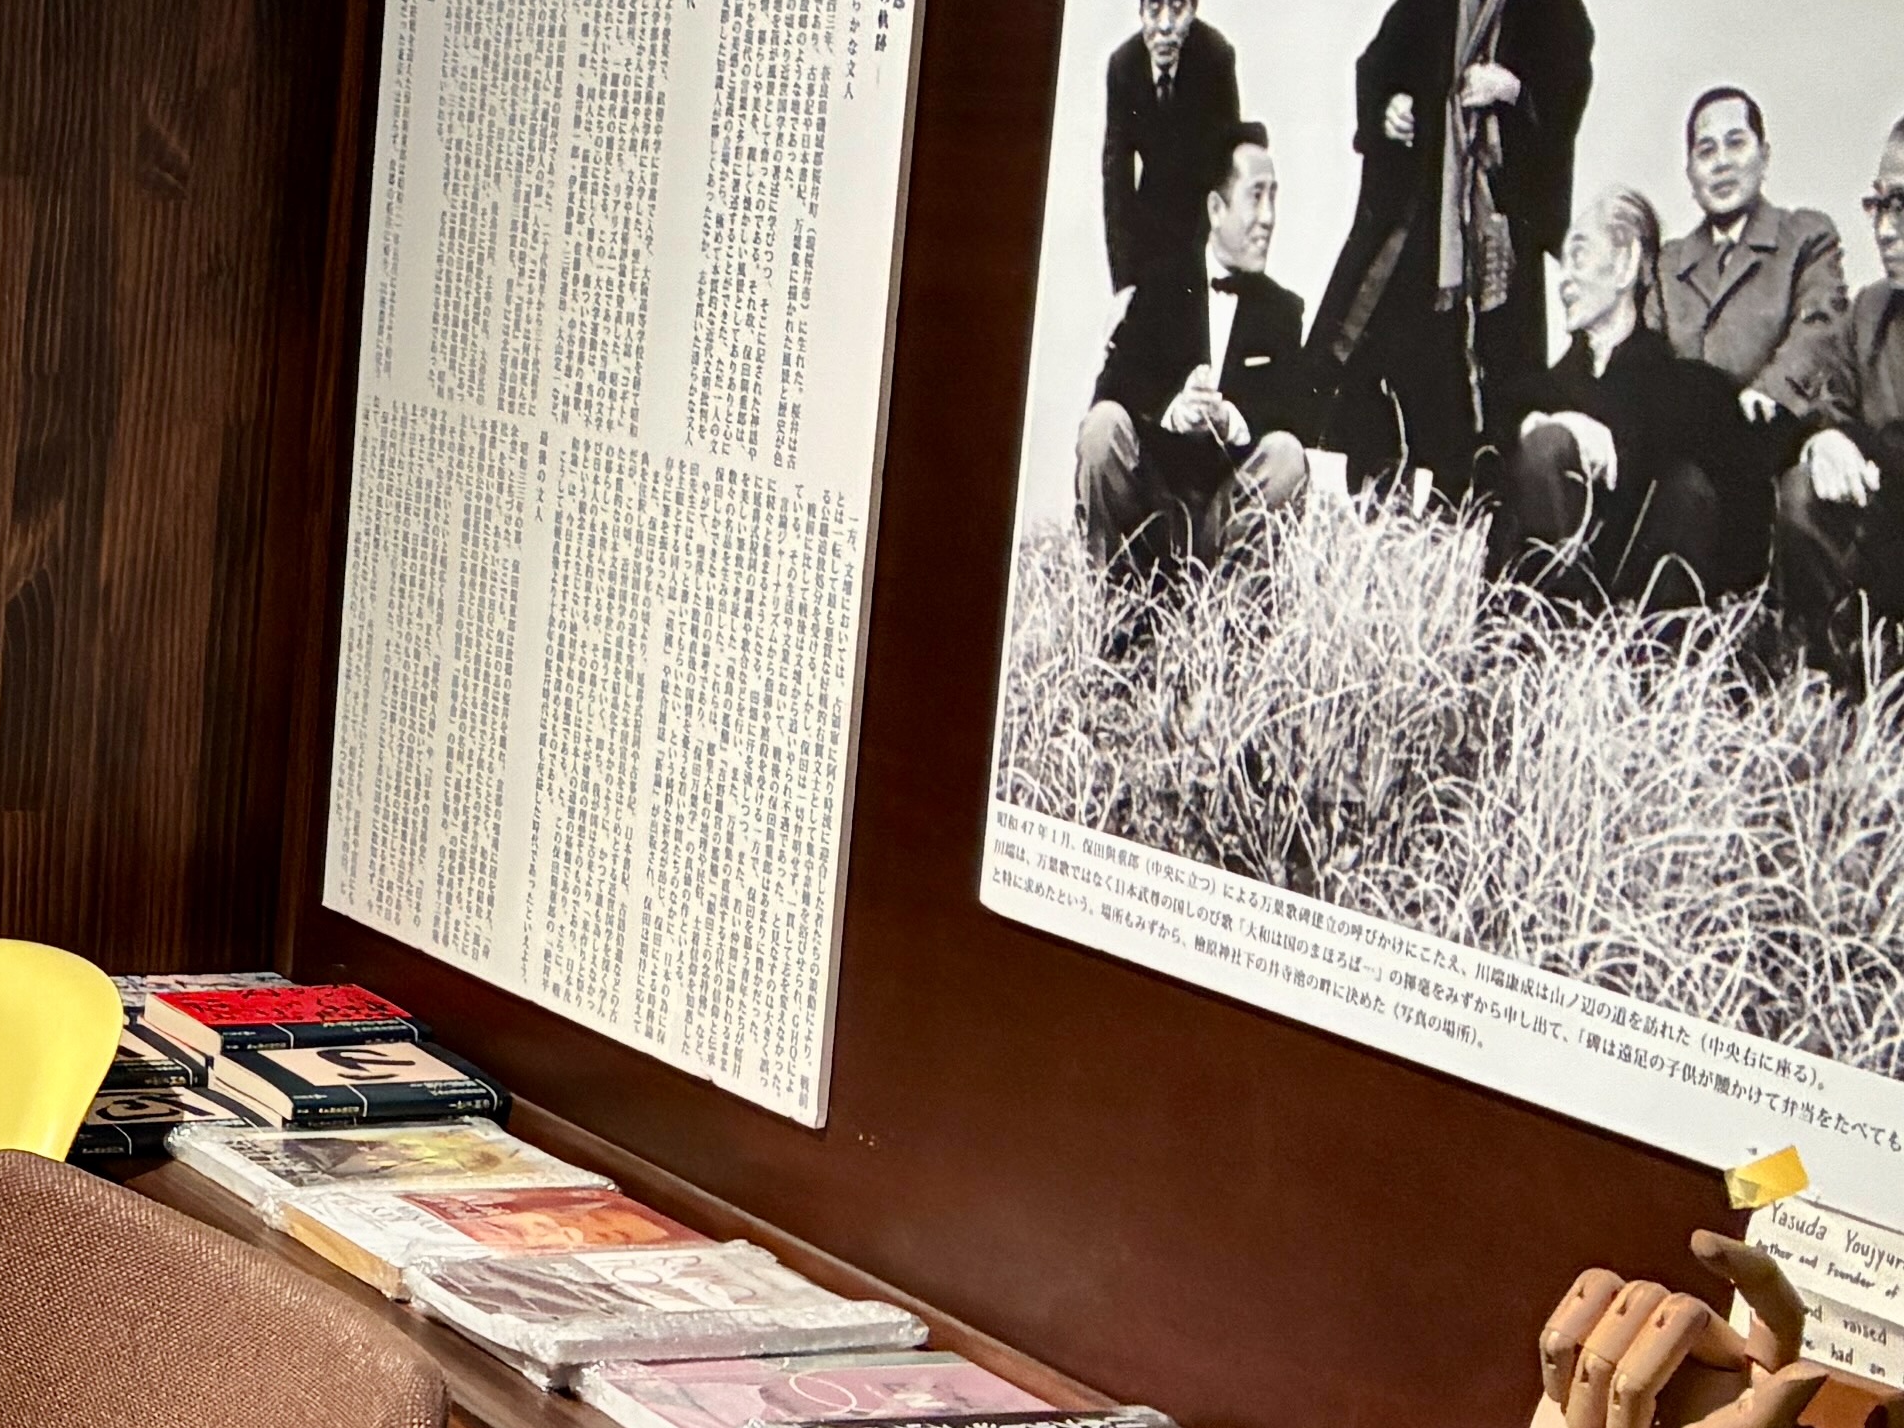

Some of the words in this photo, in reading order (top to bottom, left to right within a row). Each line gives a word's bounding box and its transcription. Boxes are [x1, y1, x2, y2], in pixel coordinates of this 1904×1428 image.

[1771, 1200, 1828, 1241] Yasuda
[1844, 1227, 1904, 1273] Youjyur
[1798, 1254, 1819, 1270] and
[1826, 1261, 1876, 1290] Founder
[1884, 1283, 1901, 1300] of
[1843, 1318, 1888, 1347] raised
[1830, 1341, 1855, 1366] had
